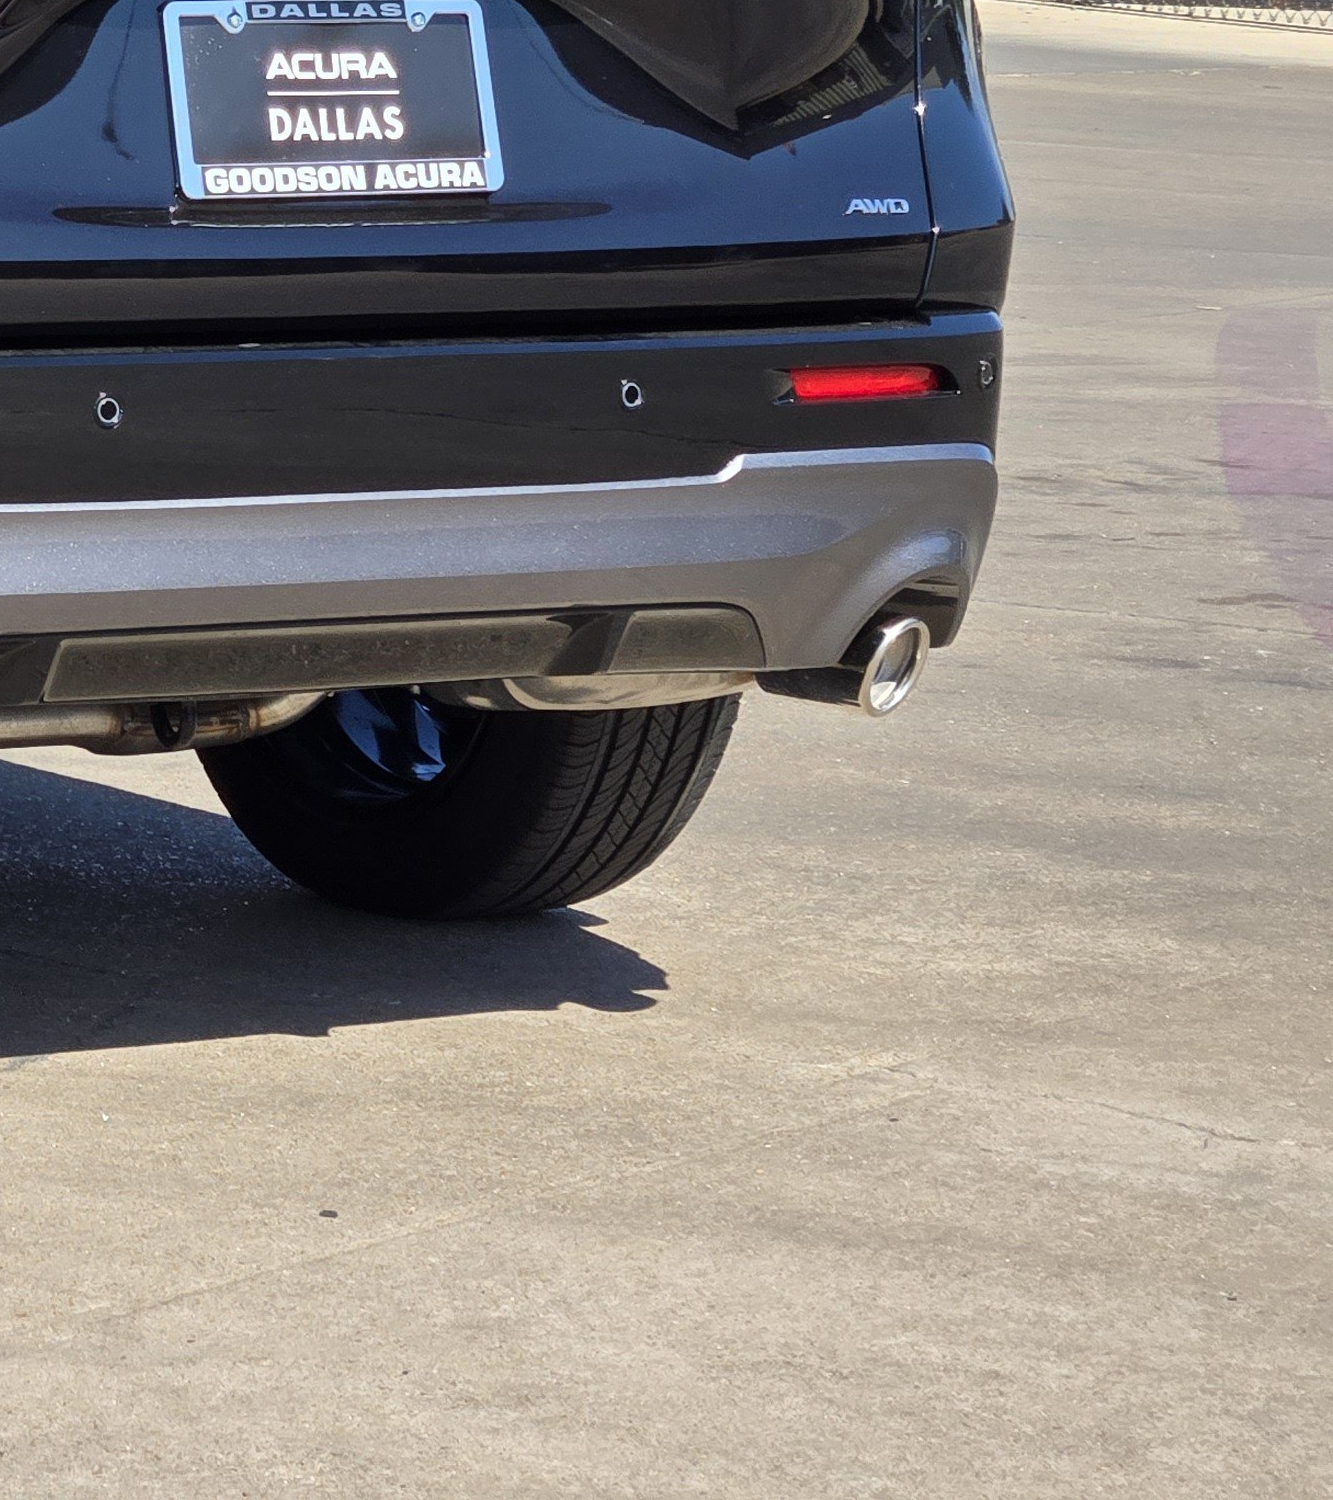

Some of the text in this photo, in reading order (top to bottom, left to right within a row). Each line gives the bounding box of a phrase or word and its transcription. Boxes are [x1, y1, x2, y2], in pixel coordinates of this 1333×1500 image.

[251, 2, 404, 19] DALLAS
[266, 52, 398, 80] ACURA
[268, 106, 404, 141] DALLAS
[204, 161, 486, 194] GOODSON ACURA
[842, 199, 910, 215] AWD
